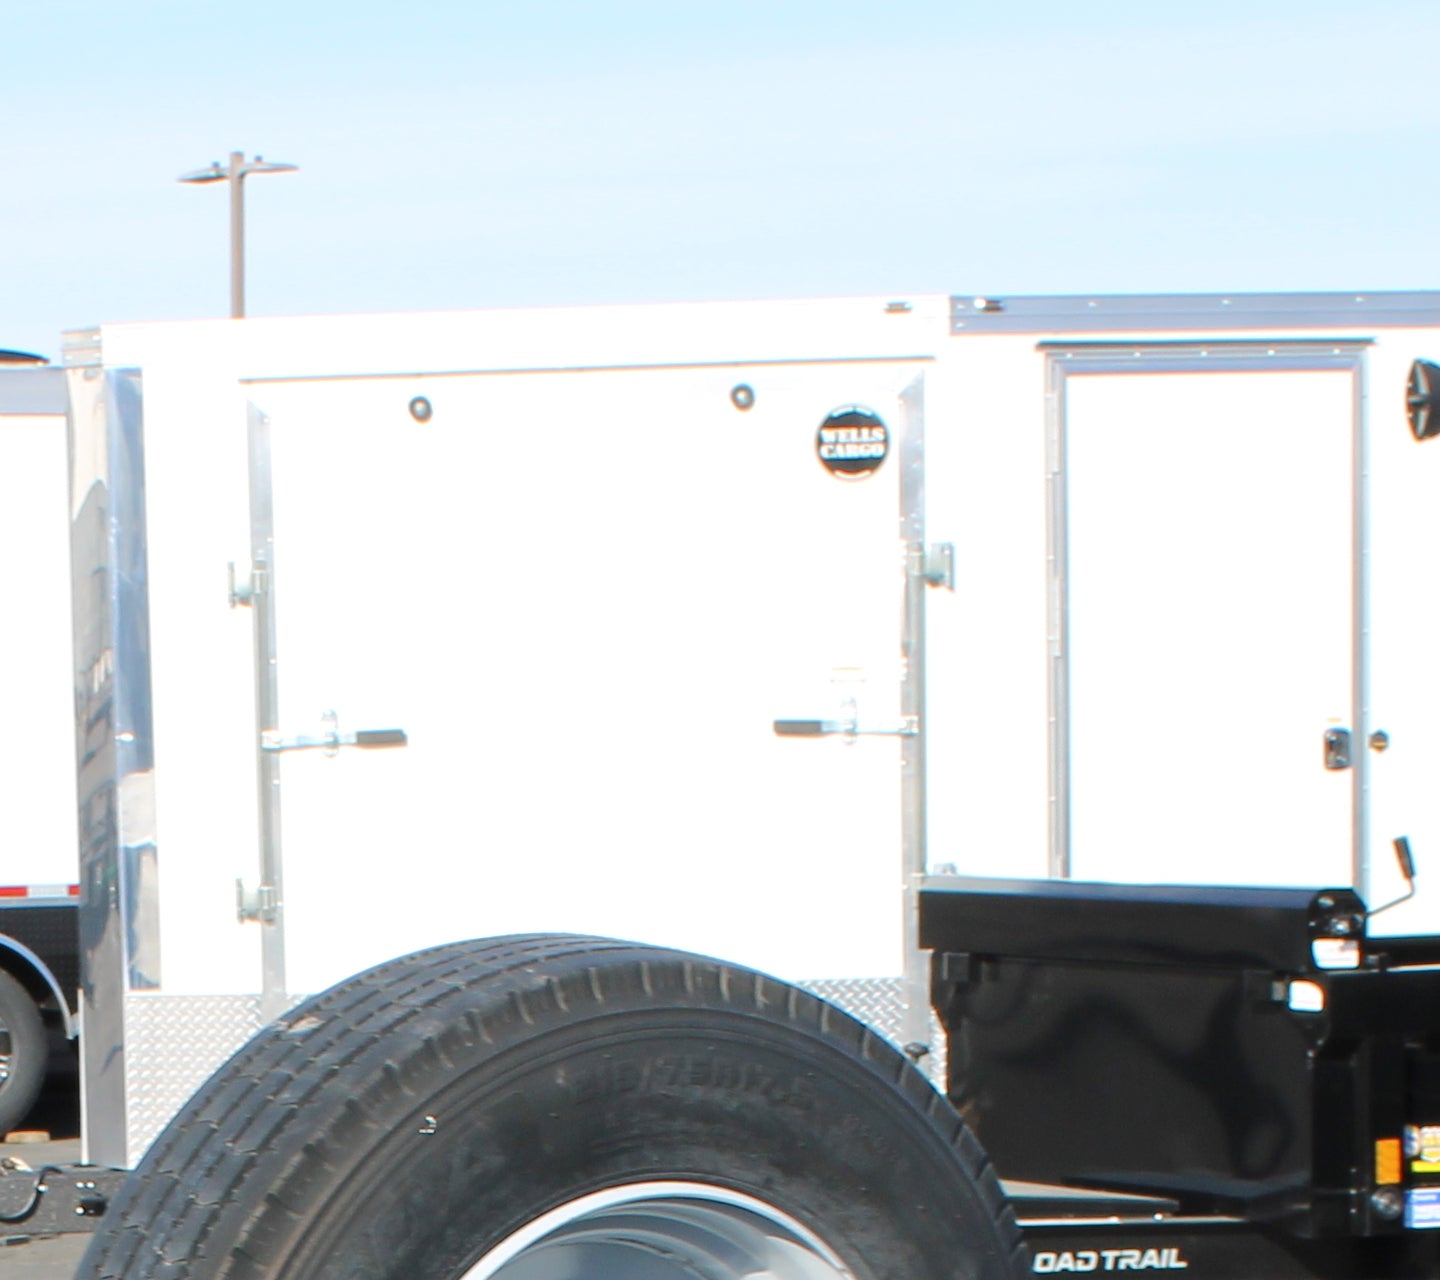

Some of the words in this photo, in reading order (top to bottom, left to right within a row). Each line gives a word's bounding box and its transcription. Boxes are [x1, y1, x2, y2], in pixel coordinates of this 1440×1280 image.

[820, 426, 886, 442] WELLS
[820, 442, 886, 459] CARGO
[1032, 1250, 1098, 1274] OAD
[1100, 1248, 1189, 1271] TRAIL
